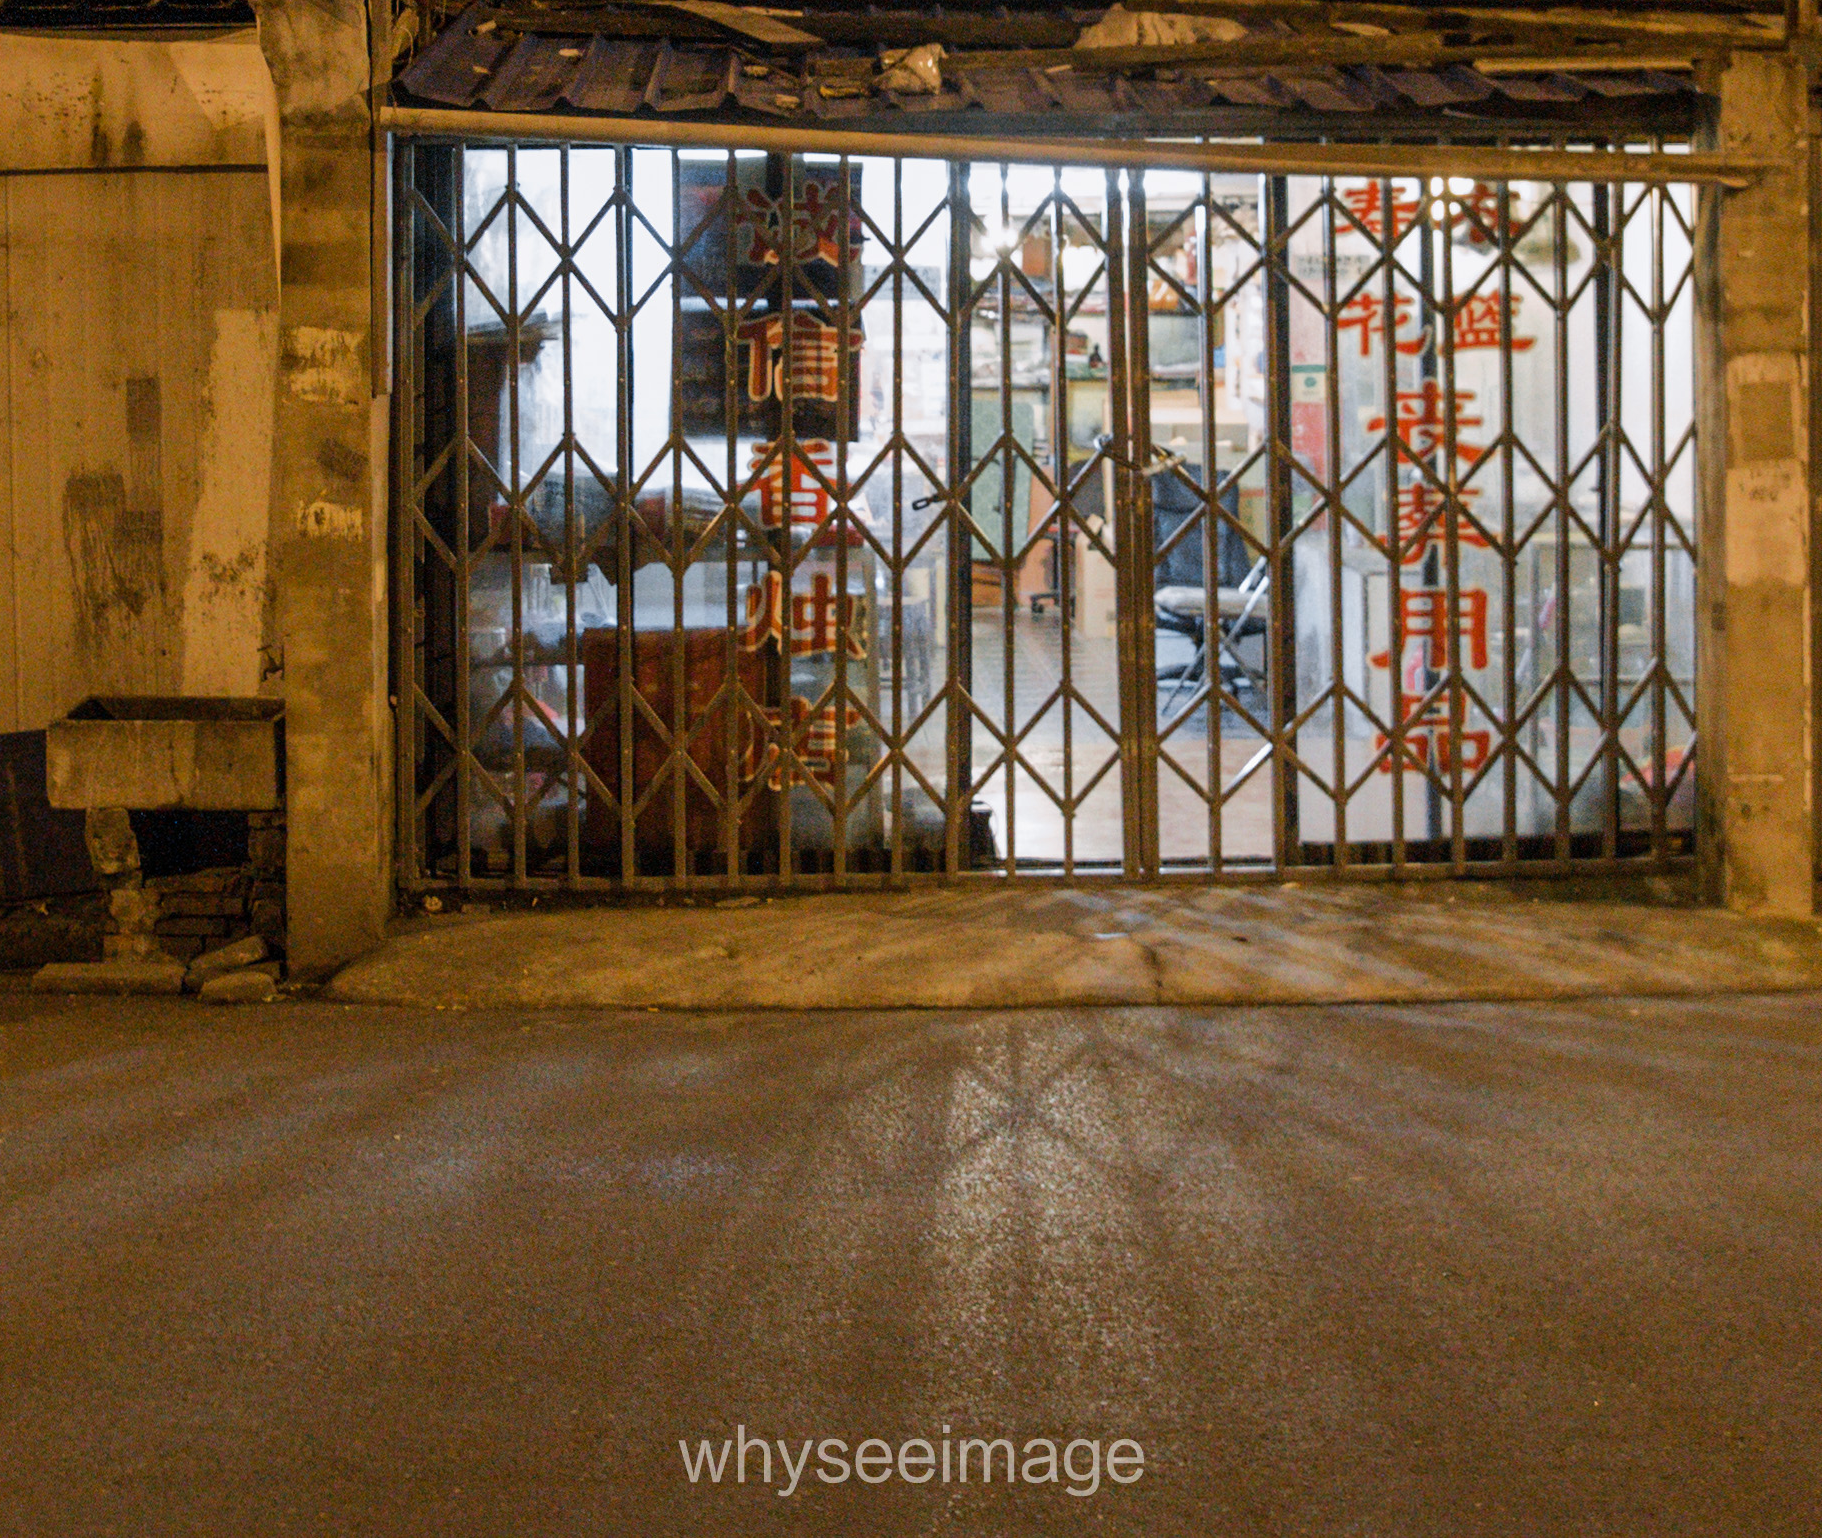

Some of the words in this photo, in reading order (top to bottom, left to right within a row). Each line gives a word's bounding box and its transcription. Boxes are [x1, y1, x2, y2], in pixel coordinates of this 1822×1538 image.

[1338, 289, 1537, 358] 花篮
[1365, 378, 1499, 777] 丧葬用品
